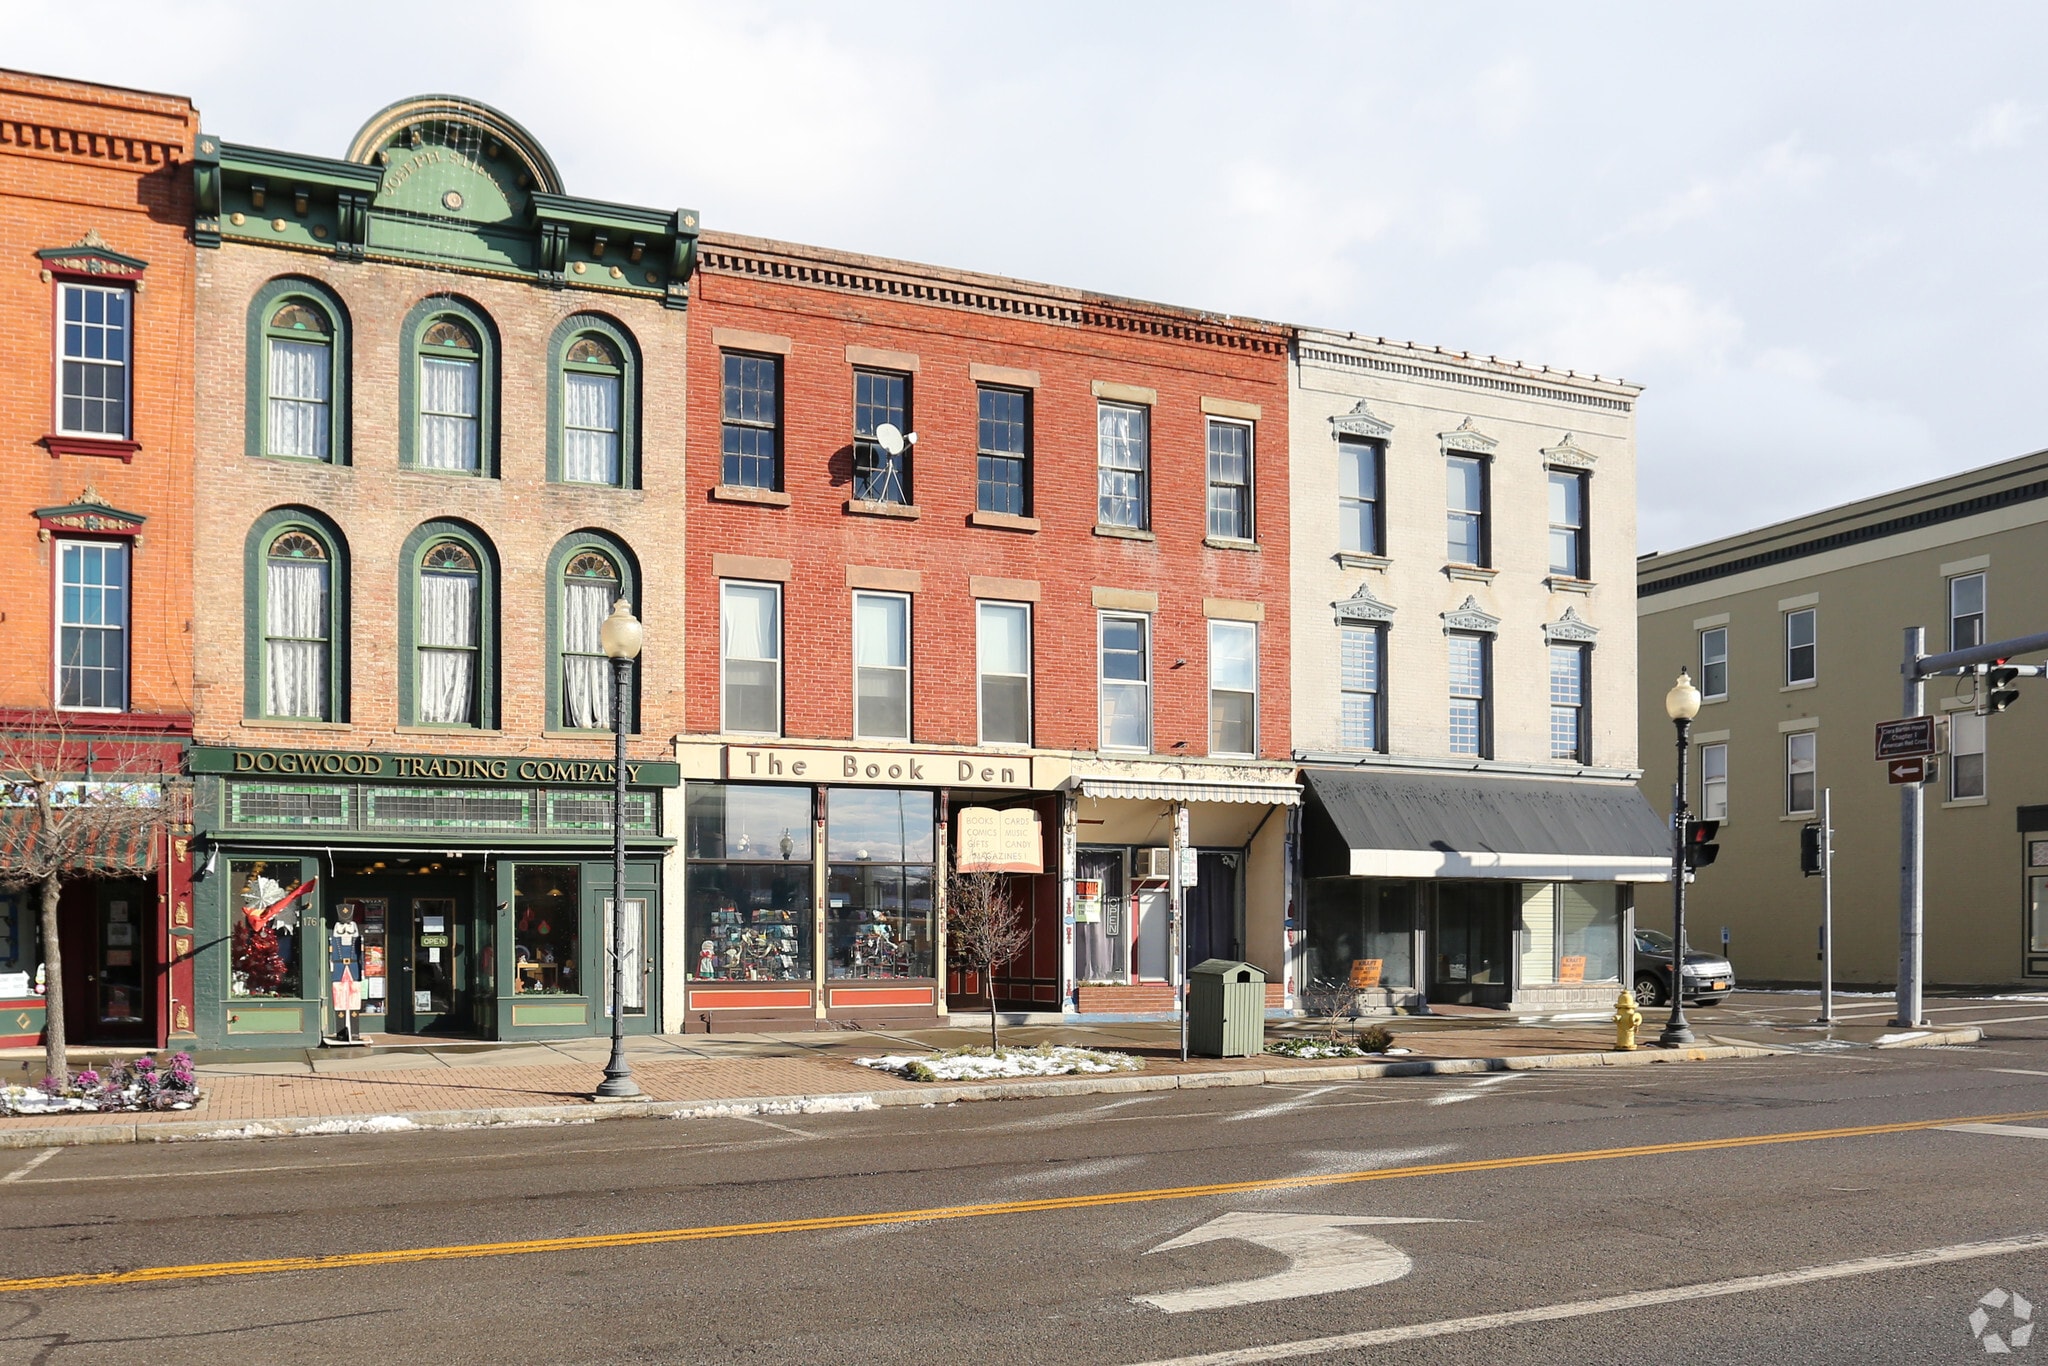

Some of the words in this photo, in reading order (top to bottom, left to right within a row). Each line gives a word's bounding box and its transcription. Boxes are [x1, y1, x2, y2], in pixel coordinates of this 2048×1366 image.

[384, 151, 442, 197] JOSEPH
[234, 752, 383, 775] DOGWOOD
[394, 757, 509, 779] TRADING
[746, 751, 808, 776] The
[843, 755, 925, 779] Book
[958, 759, 1015, 783] Den
[966, 816, 994, 825] BOOKS
[1004, 817, 1030, 826] CARDS
[966, 828, 997, 837] COMICS
[1005, 829, 1028, 837] MUSIC
[967, 840, 989, 848] GIFTS
[1005, 840, 1032, 849] CANDY
[1086, 882, 1098, 895] SALE
[1109, 898, 1117, 933] OPEN
[303, 916, 317, 926] 176
